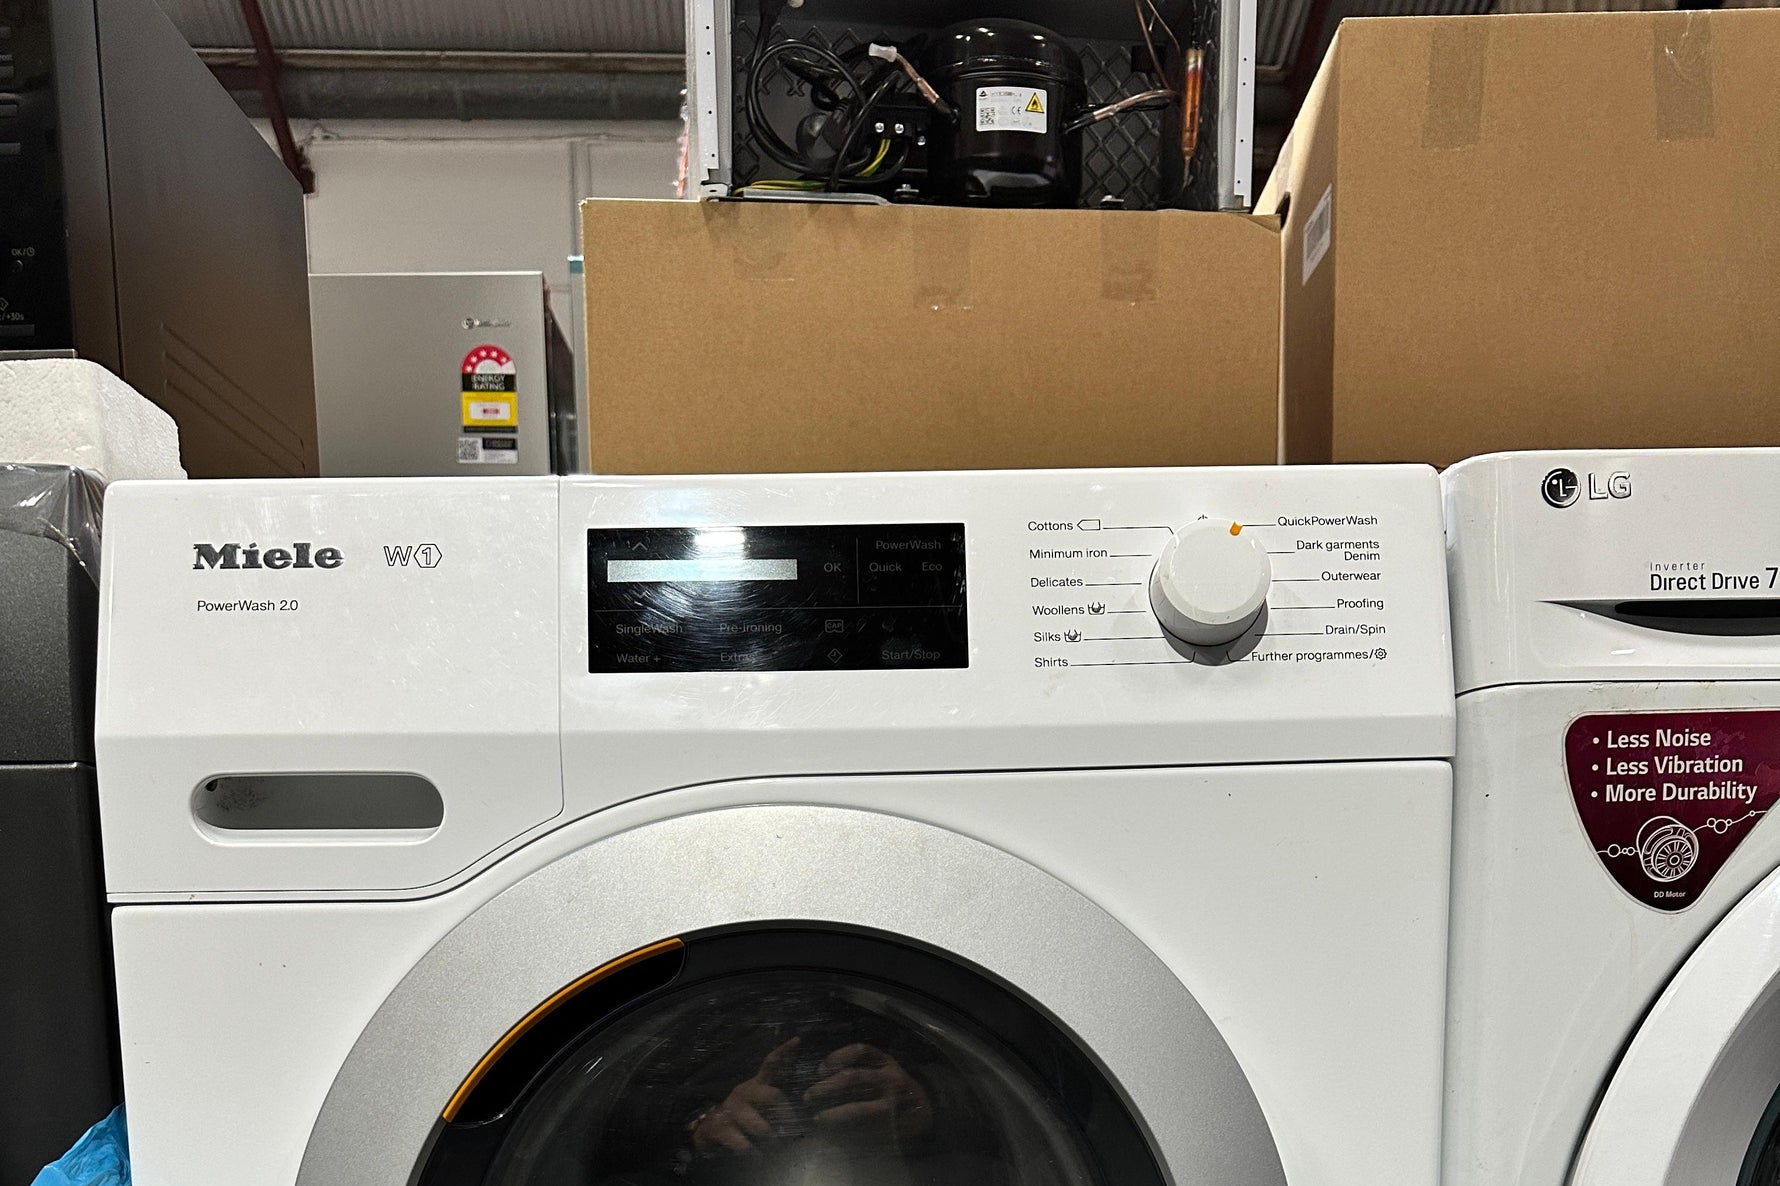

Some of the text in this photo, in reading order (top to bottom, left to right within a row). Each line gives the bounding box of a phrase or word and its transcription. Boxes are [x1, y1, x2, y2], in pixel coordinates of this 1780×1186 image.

[1588, 471, 1632, 500] LG
[1027, 520, 1074, 532] Cottons
[1277, 515, 1378, 527] QuickPowerWash
[875, 540, 942, 551] PowerWash
[1296, 540, 1380, 552] Dark garments
[192, 543, 344, 570] Miele
[1029, 549, 1108, 560] Minimum iron
[1344, 551, 1381, 561] Denim
[823, 562, 842, 573] OK
[869, 561, 943, 573] Quick Eco
[1650, 561, 1705, 572] Inverter
[1030, 577, 1083, 588] Delicates
[1321, 571, 1382, 582] Outerwear
[1650, 573, 1707, 591] Direct
[1711, 573, 1760, 590] Drive
[196, 600, 299, 612] PowerWash 2.0
[1337, 598, 1384, 610] Proofing
[1032, 605, 1085, 616] Woollens
[615, 623, 683, 636] SingleWash
[719, 621, 782, 635] Pre-ironing
[1325, 624, 1386, 636] Drain/Spin
[1033, 632, 1061, 642] Silks
[616, 653, 650, 664] Water
[881, 649, 941, 661] Start/Stop
[1251, 651, 1293, 662] Further
[1034, 657, 1069, 667] Shirts
[1607, 728, 1711, 749] Less Noise
[1606, 755, 1743, 776] Less Vibration
[1605, 780, 1758, 805] More Durability
